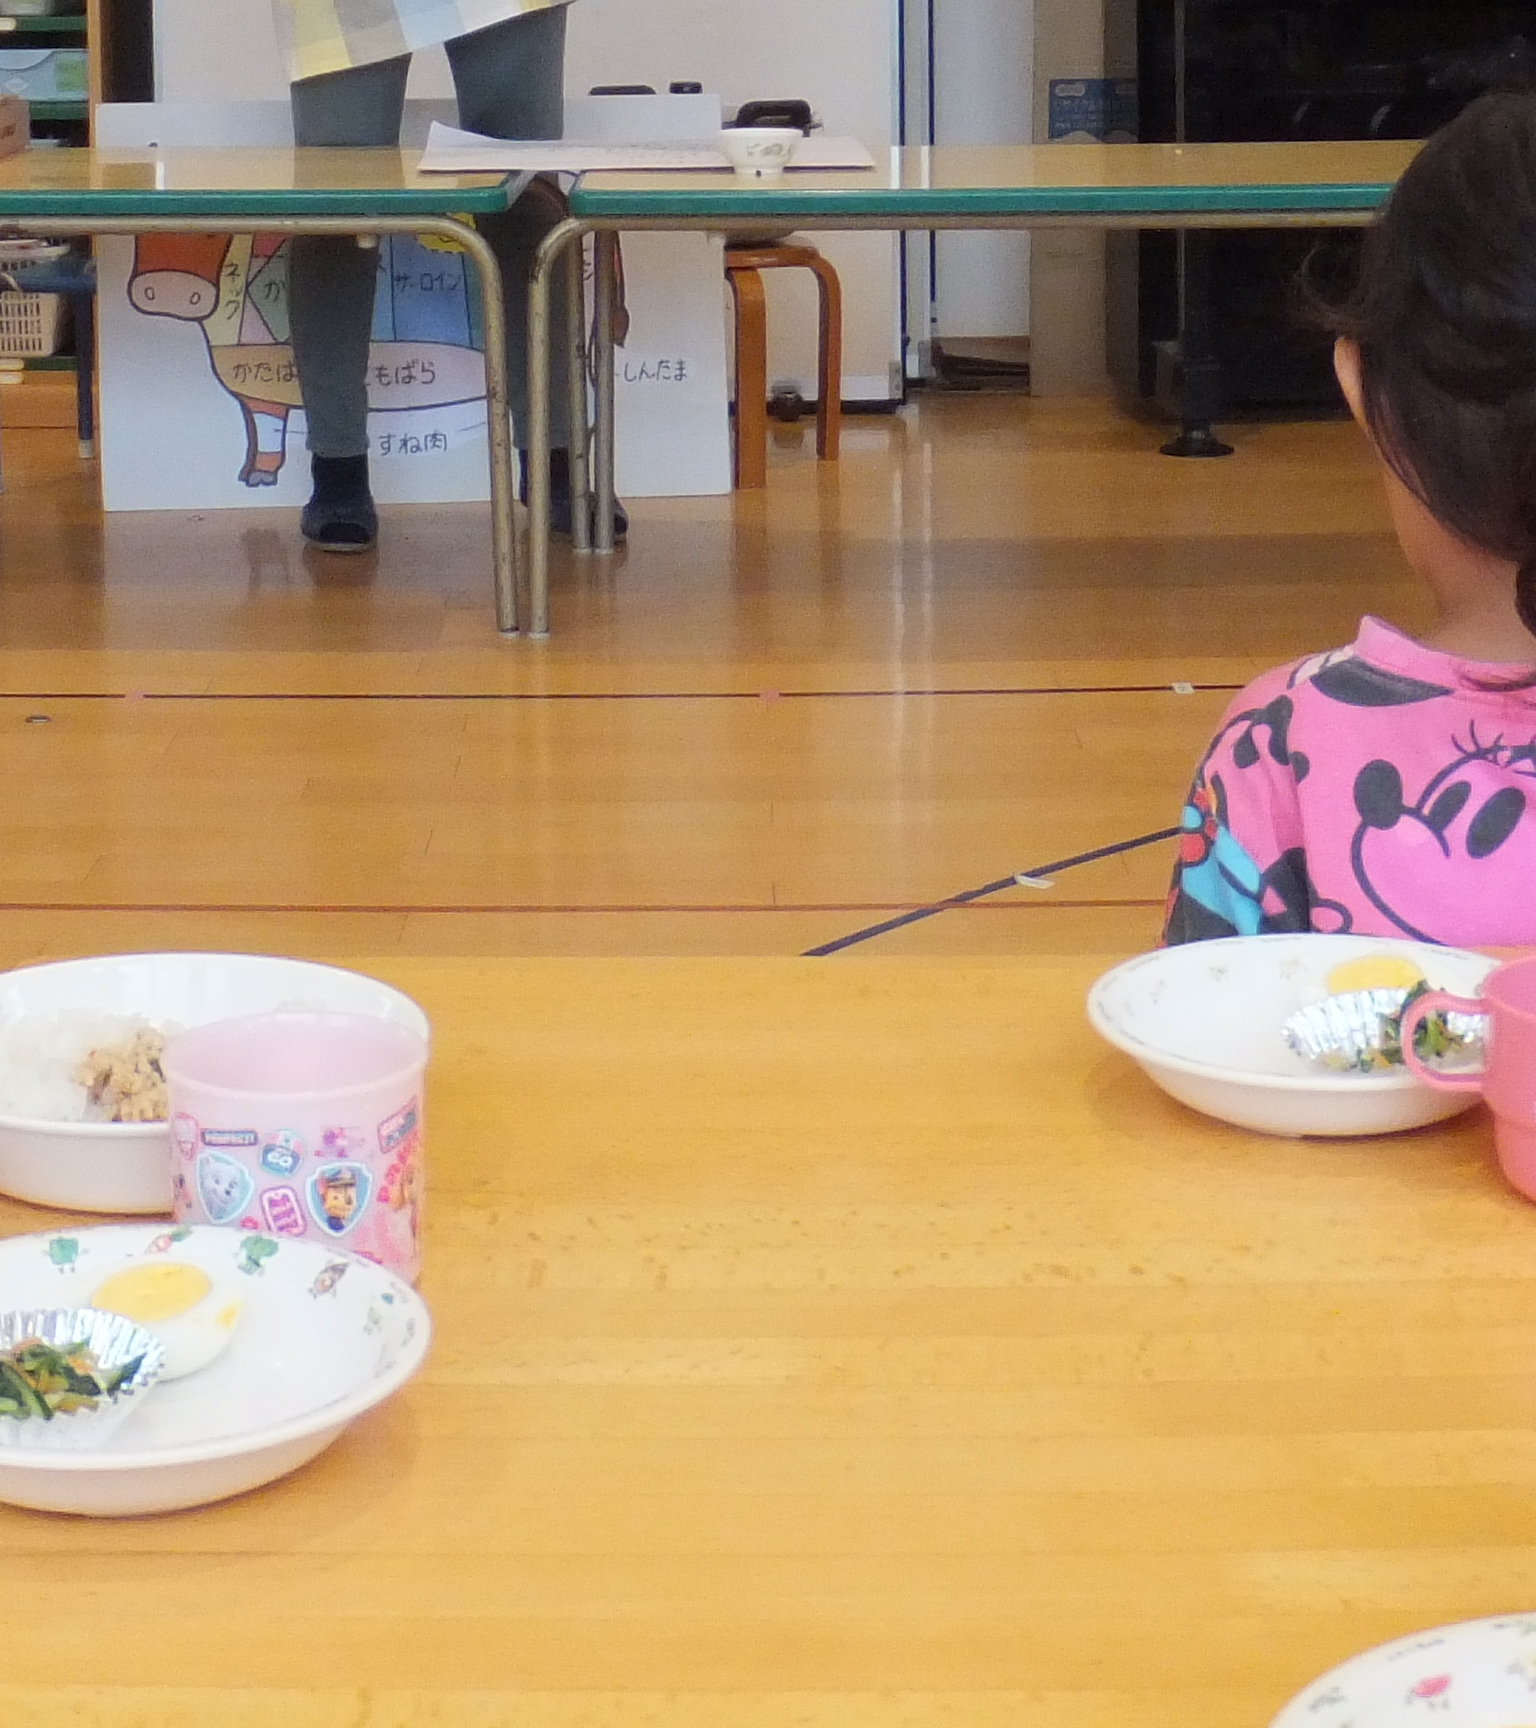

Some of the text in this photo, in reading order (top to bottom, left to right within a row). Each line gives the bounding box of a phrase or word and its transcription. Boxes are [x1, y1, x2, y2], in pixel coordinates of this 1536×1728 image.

[223, 262, 241, 320] ネック
[366, 360, 437, 386] もばら
[624, 360, 688, 382] しんたま
[379, 433, 448, 457] すね肉
